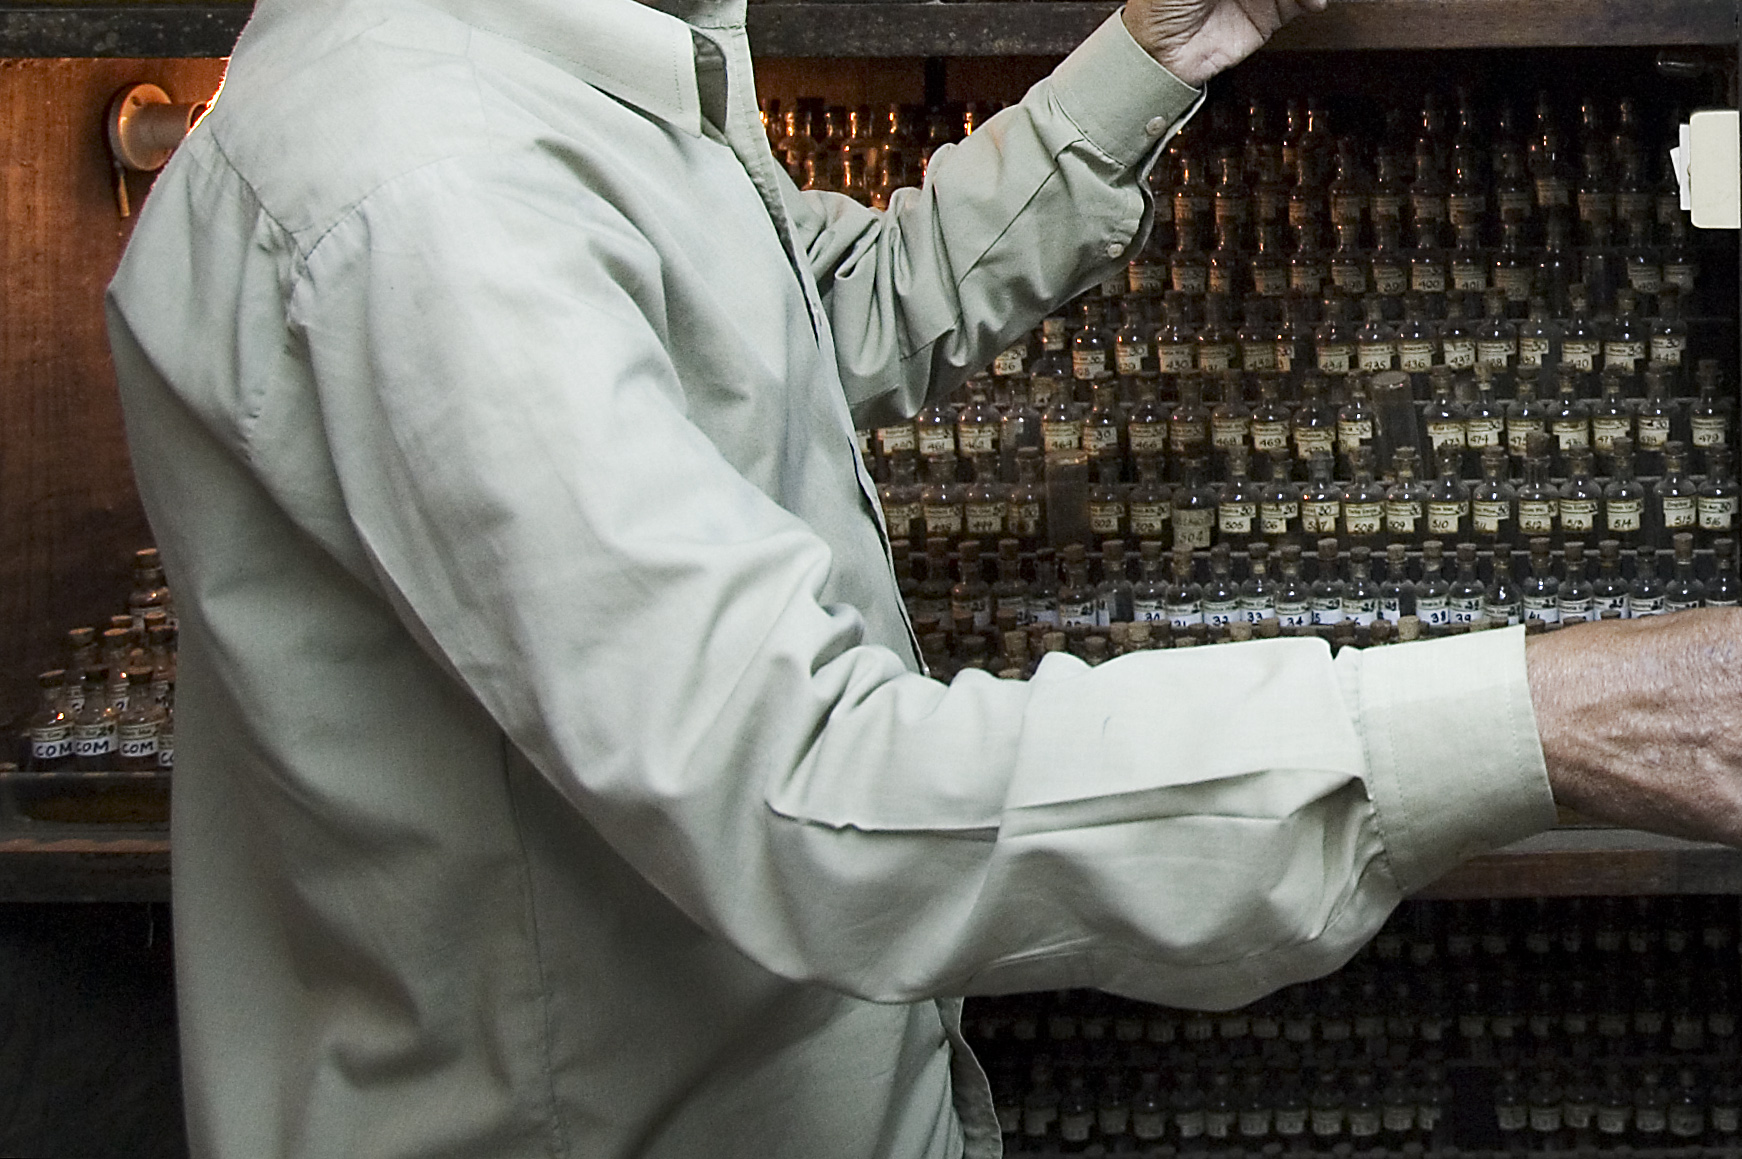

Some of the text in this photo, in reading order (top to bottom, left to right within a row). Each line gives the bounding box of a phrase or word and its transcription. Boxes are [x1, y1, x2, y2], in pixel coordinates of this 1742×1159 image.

[1431, 611, 1447, 623] 38
[35, 743, 73, 757] COM
[75, 742, 110, 754] COM
[122, 742, 154, 754] COM
